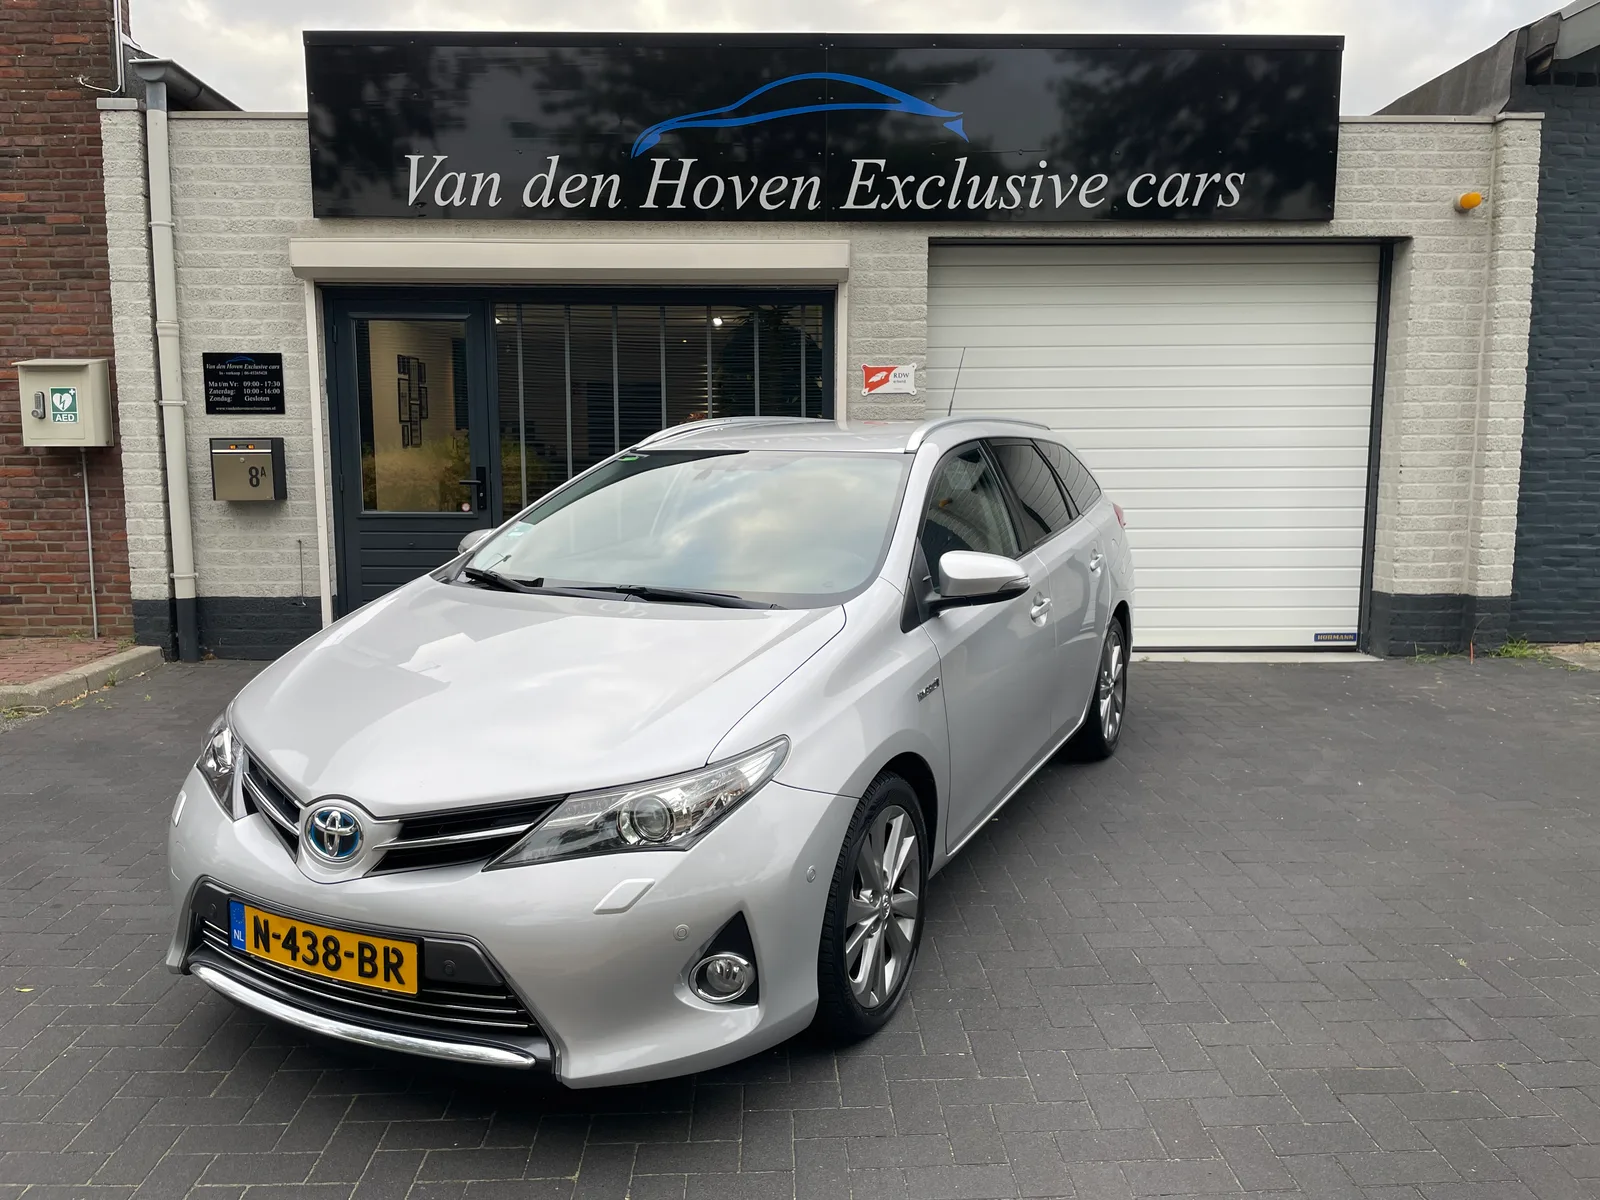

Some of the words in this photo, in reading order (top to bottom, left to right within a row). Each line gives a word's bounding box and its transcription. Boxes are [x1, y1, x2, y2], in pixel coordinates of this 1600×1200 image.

[404, 154, 502, 207] Van
[522, 155, 622, 208] den
[639, 158, 821, 210] Hoven
[839, 156, 1109, 210] Exclusive
[1126, 171, 1246, 208] cars
[209, 395, 233, 403] Zondag:
[55, 413, 75, 422] AED
[233, 929, 245, 942] NL
[253, 914, 406, 985] N-438-BR
